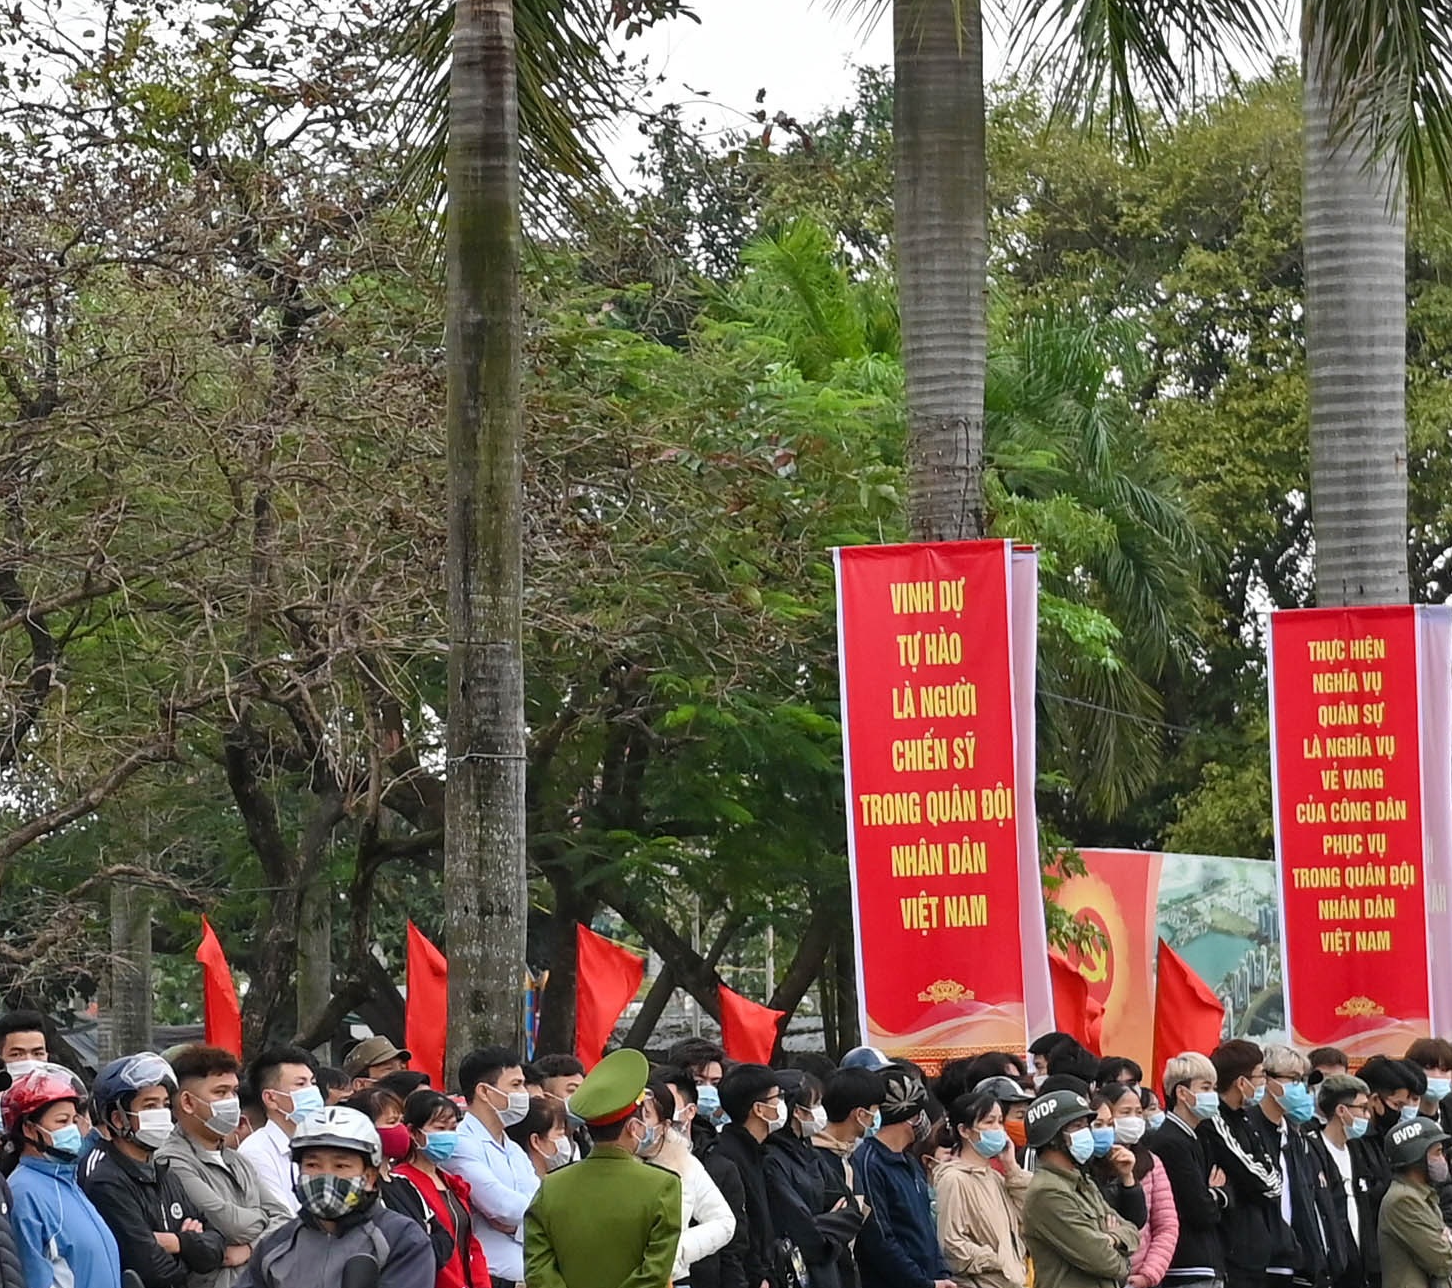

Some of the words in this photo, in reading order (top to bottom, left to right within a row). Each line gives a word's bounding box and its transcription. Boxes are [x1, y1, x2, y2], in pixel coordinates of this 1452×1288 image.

[889, 581, 935, 615] VINH
[938, 577, 965, 619] DỰ
[896, 632, 922, 673] TỰ
[925, 631, 962, 665] HÀO
[1307, 639, 1346, 663] THỰC
[1350, 636, 1385, 663] HIỆN
[892, 679, 917, 720] LÀ
[920, 676, 977, 718] NGƯỜI
[1312, 672, 1358, 695] NGHĨA
[1362, 670, 1382, 697] VỤ
[1317, 704, 1359, 728] QUÂN
[1363, 700, 1385, 728] SỰ
[892, 727, 948, 772] CHIẾN
[952, 730, 976, 770] SỸ
[1303, 735, 1323, 760] LÀ
[1326, 735, 1372, 758] NGHĨA
[1376, 735, 1395, 760] VỤ
[1320, 760, 1339, 790] VẺ
[1342, 768, 1384, 790] VANG
[859, 793, 921, 827] TRONG
[926, 783, 976, 827] QUÂN
[980, 782, 1013, 827] ĐỘI
[1296, 793, 1327, 823] CỦA
[1330, 797, 1372, 823] CÔNG
[1375, 796, 1407, 821] DÂN
[890, 837, 943, 878] NHÂN
[948, 836, 987, 875] DÂN
[1323, 834, 1364, 857] PHỤC
[1368, 832, 1387, 858] VỤ
[1292, 867, 1342, 890] TRONG
[1345, 862, 1387, 890] QUÂN
[1389, 861, 1415, 890] ĐỘI
[900, 891, 939, 936] VIỆT
[944, 895, 987, 928] NAM
[1318, 894, 1360, 920] NHÂN
[1364, 893, 1395, 919] DÂN
[1320, 927, 1352, 956] VIỆT
[1356, 930, 1391, 952] NAM
[1028, 1099, 1057, 1124] BVDP
[1392, 1122, 1422, 1145] BVDP
